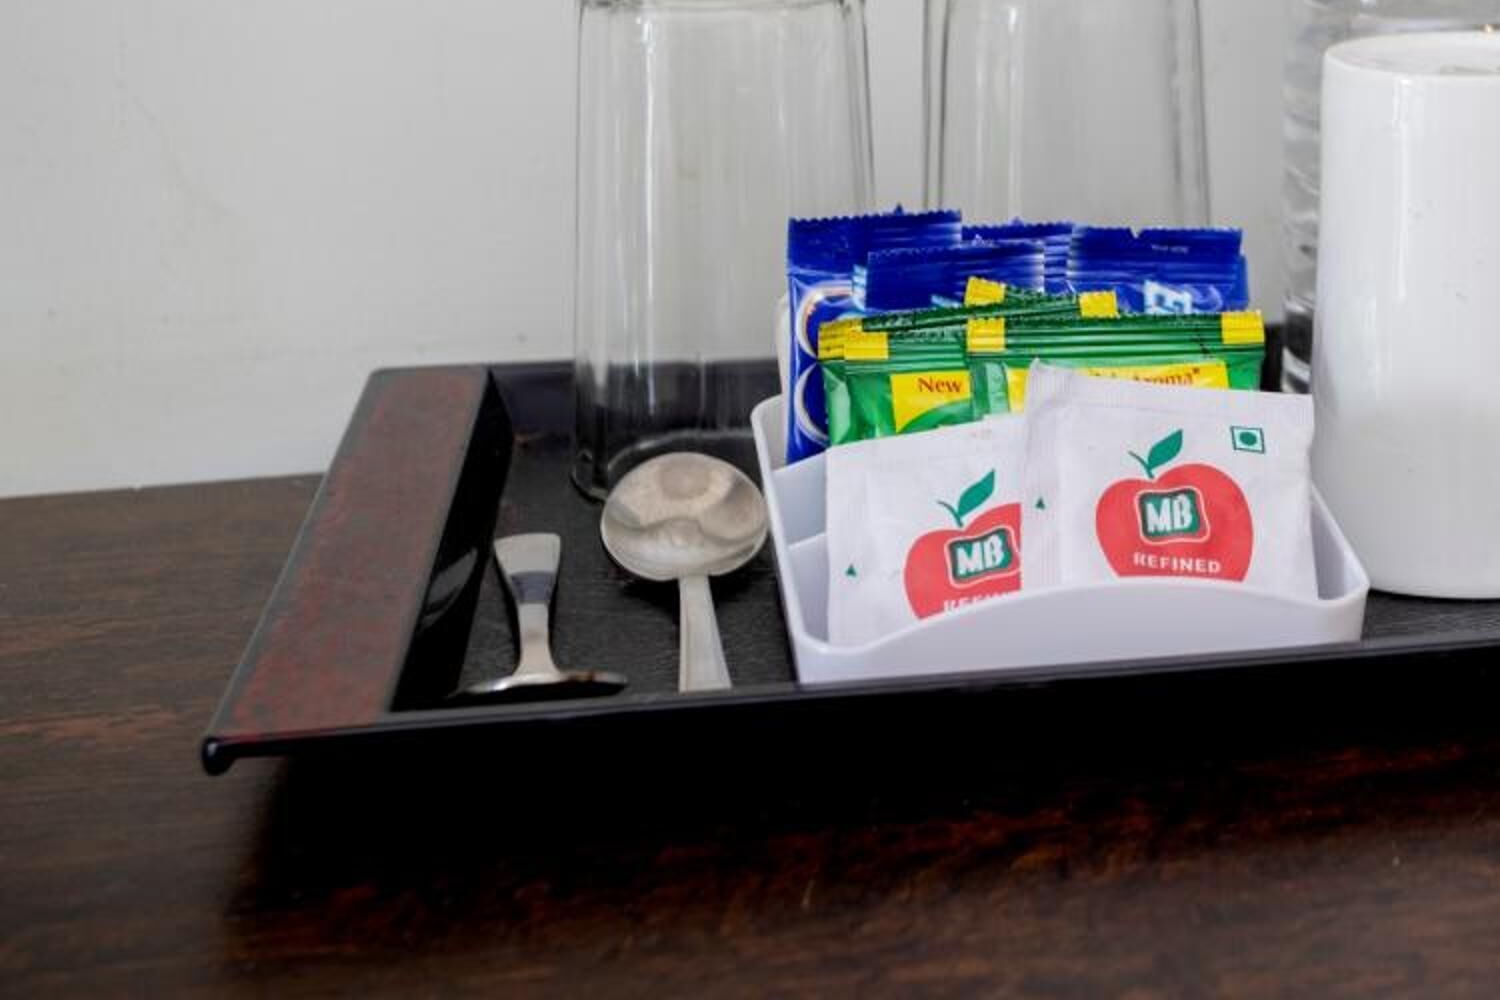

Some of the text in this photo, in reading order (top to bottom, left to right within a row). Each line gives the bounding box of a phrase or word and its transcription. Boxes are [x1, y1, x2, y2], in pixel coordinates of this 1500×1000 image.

[917, 377, 961, 393] New
[1146, 493, 1193, 532] MB
[957, 534, 1005, 575] MB
[1133, 551, 1221, 573] REFINED
